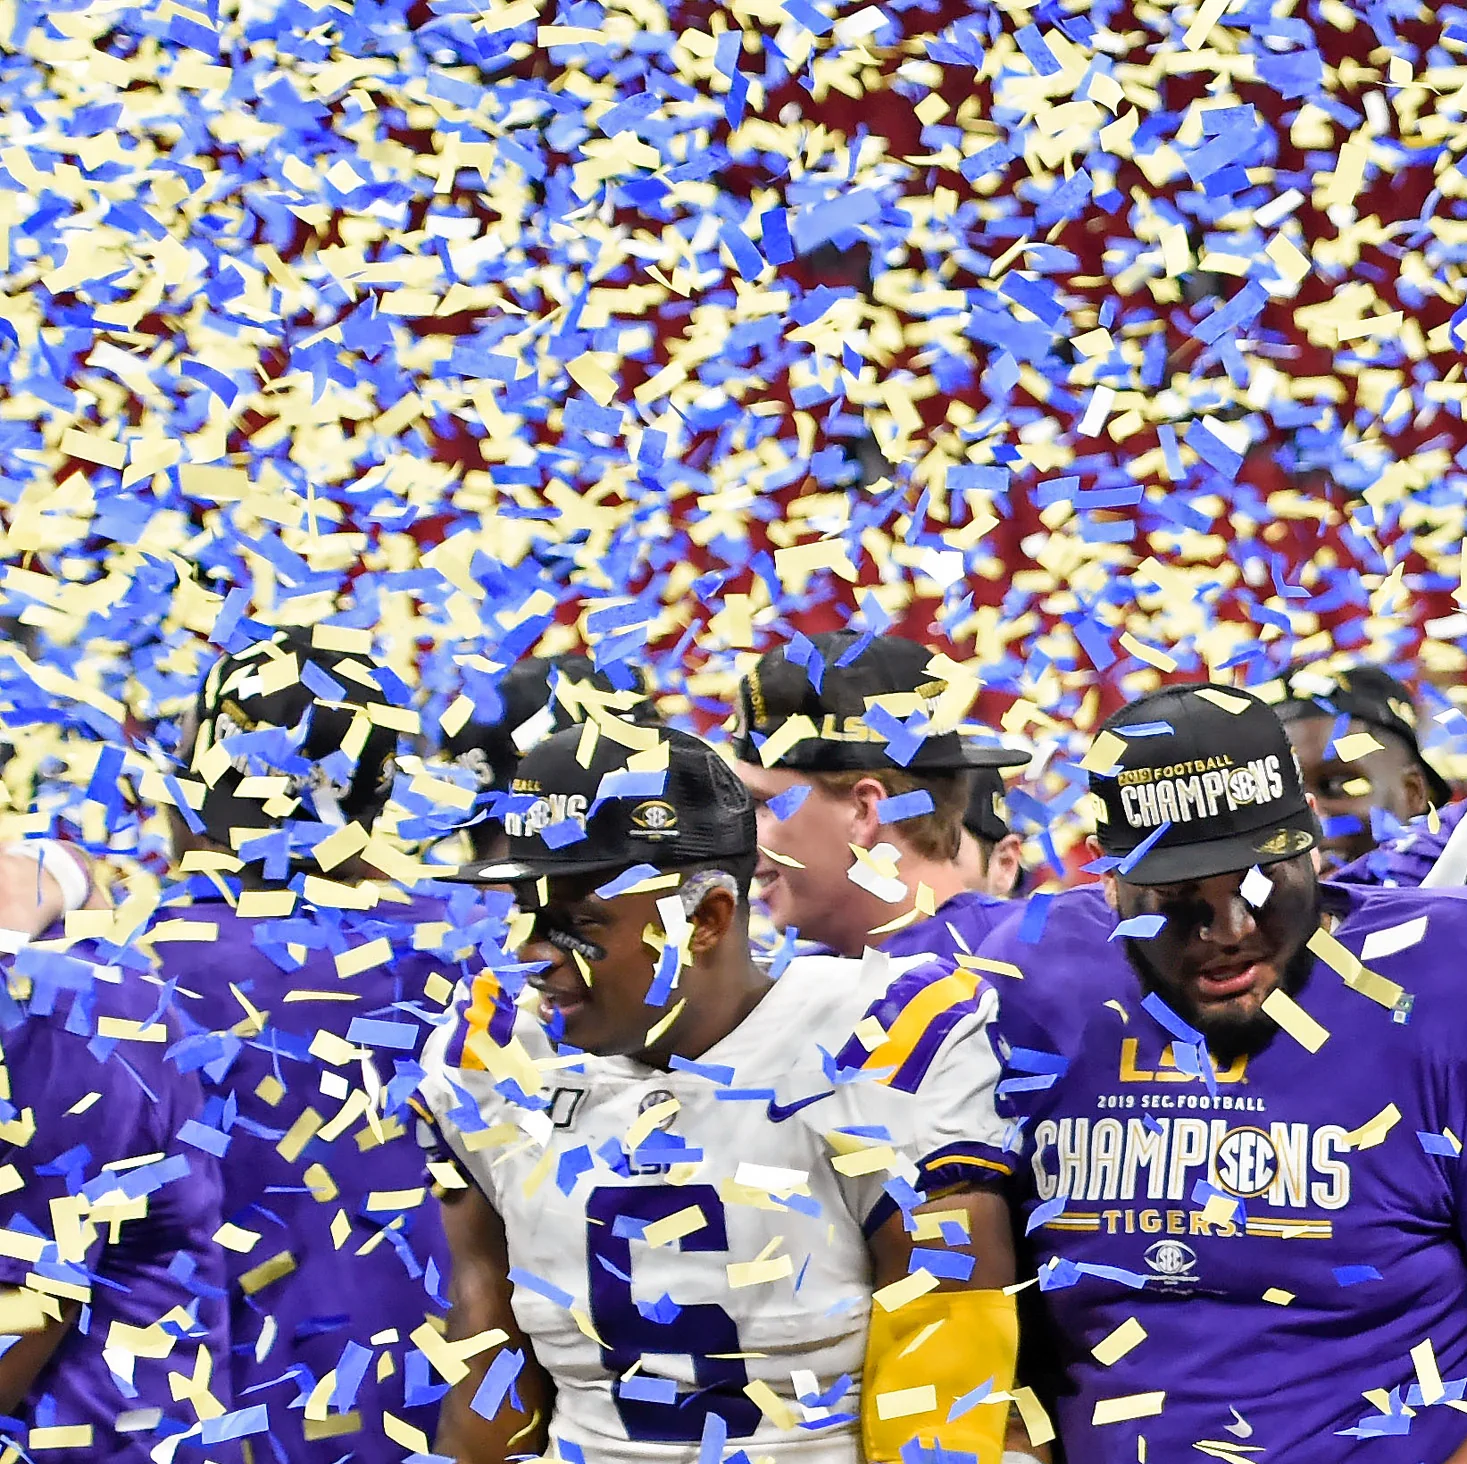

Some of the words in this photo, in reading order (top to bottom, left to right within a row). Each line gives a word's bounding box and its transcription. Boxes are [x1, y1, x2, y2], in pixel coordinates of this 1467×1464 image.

[821, 713, 891, 743] LS
[1118, 768, 1153, 787] 2019
[1153, 754, 1234, 781] FOOTBALL
[1097, 1095, 1135, 1109] 2019
[1177, 1095, 1265, 1112] FOOTBALL
[587, 1185, 764, 1442] 6
